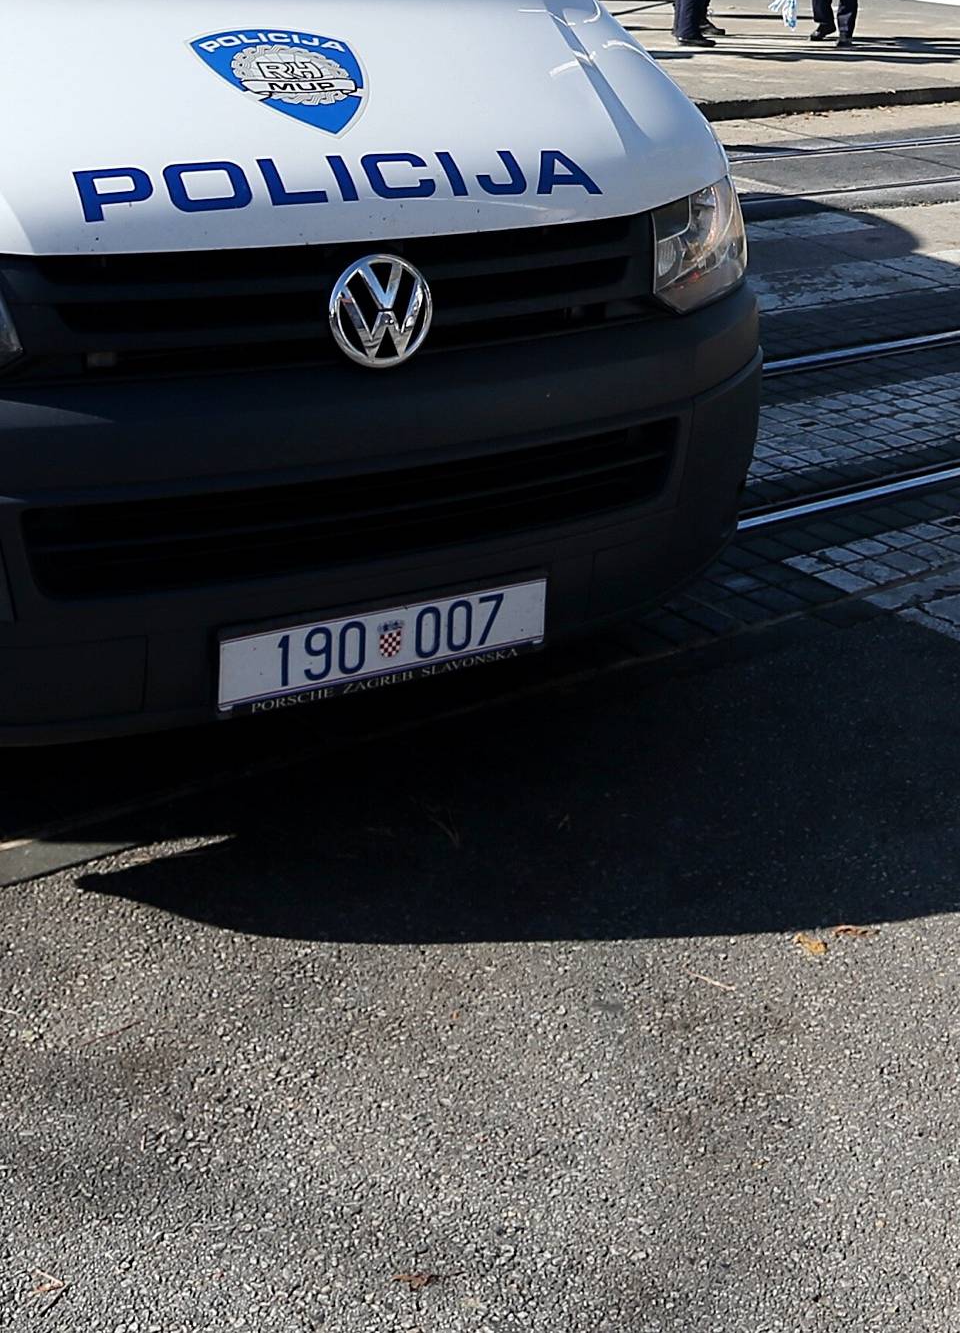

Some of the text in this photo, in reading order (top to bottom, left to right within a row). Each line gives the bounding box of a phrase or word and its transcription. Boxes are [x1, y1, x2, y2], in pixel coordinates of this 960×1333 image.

[198, 32, 346, 53] POLICIJA
[257, 61, 324, 79] RH
[269, 82, 336, 92] MUP
[72, 149, 603, 223] POLICIJA
[277, 592, 505, 687] 190 007
[250, 647, 519, 714] PORSCHE ZAGREB SLAVONSKA
